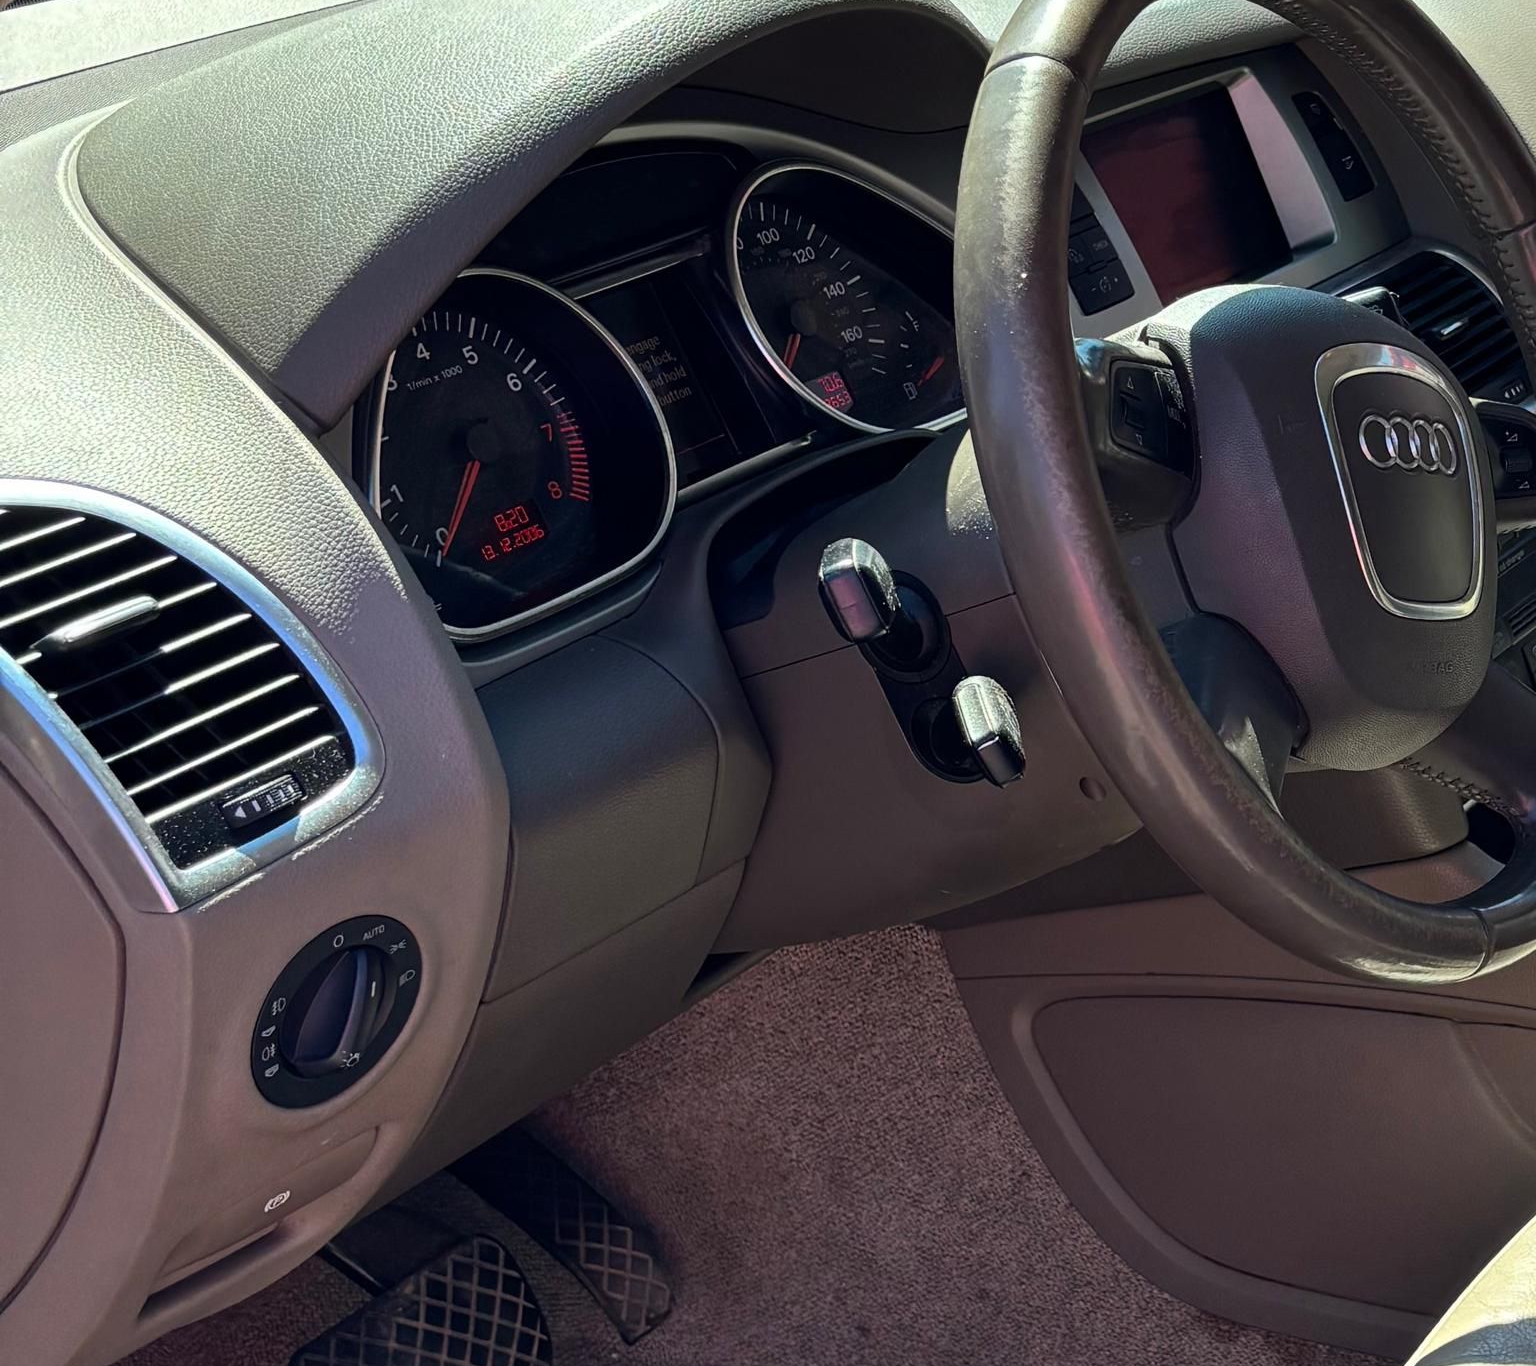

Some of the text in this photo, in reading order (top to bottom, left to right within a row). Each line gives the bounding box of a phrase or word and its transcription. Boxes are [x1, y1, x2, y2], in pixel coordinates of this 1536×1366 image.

[756, 227, 780, 246] 100
[792, 245, 815, 264] 120
[823, 281, 846, 299] 140
[840, 326, 863, 344] 160
[415, 342, 431, 361] 4
[462, 345, 479, 365] 5
[406, 374, 433, 391] 1/min
[441, 364, 463, 379] 1000
[506, 372, 522, 392] 6
[539, 422, 553, 442] 7
[390, 484, 404, 502] 1
[547, 481, 563, 499] 8
[362, 924, 385, 941] AUTO
